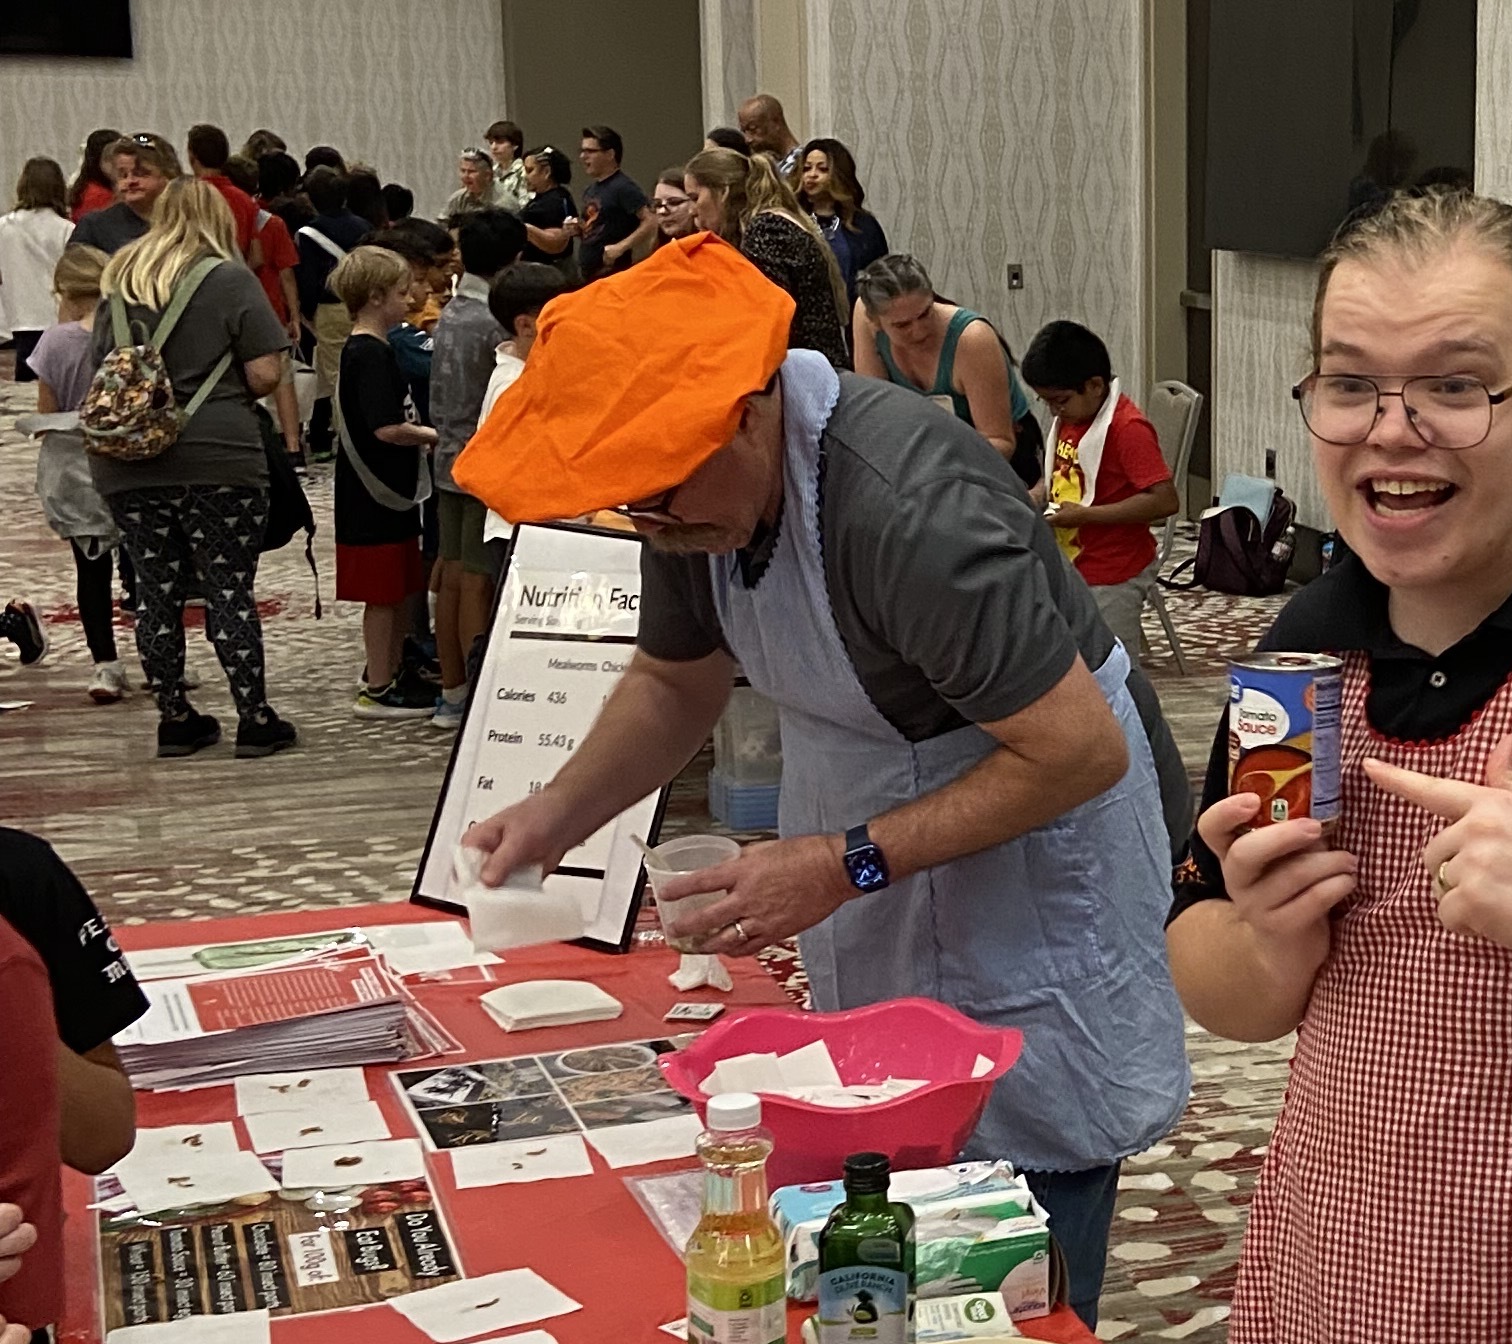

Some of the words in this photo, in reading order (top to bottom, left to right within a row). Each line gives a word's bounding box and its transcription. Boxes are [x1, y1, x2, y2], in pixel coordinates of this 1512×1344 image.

[520, 585, 603, 610] Nutritin
[609, 587, 639, 611] Fac
[497, 688, 536, 703] Calories
[547, 692, 567, 704] 436
[1238, 719, 1277, 735] Sauce
[487, 730, 523, 744] Protein
[477, 776, 494, 790] Fat
[405, 1213, 429, 1226] Do
[356, 1230, 380, 1245] Eat
[410, 1225, 433, 1243] You
[415, 1243, 449, 1277] Already
[830, 1272, 895, 1286] CALIFORNIA
